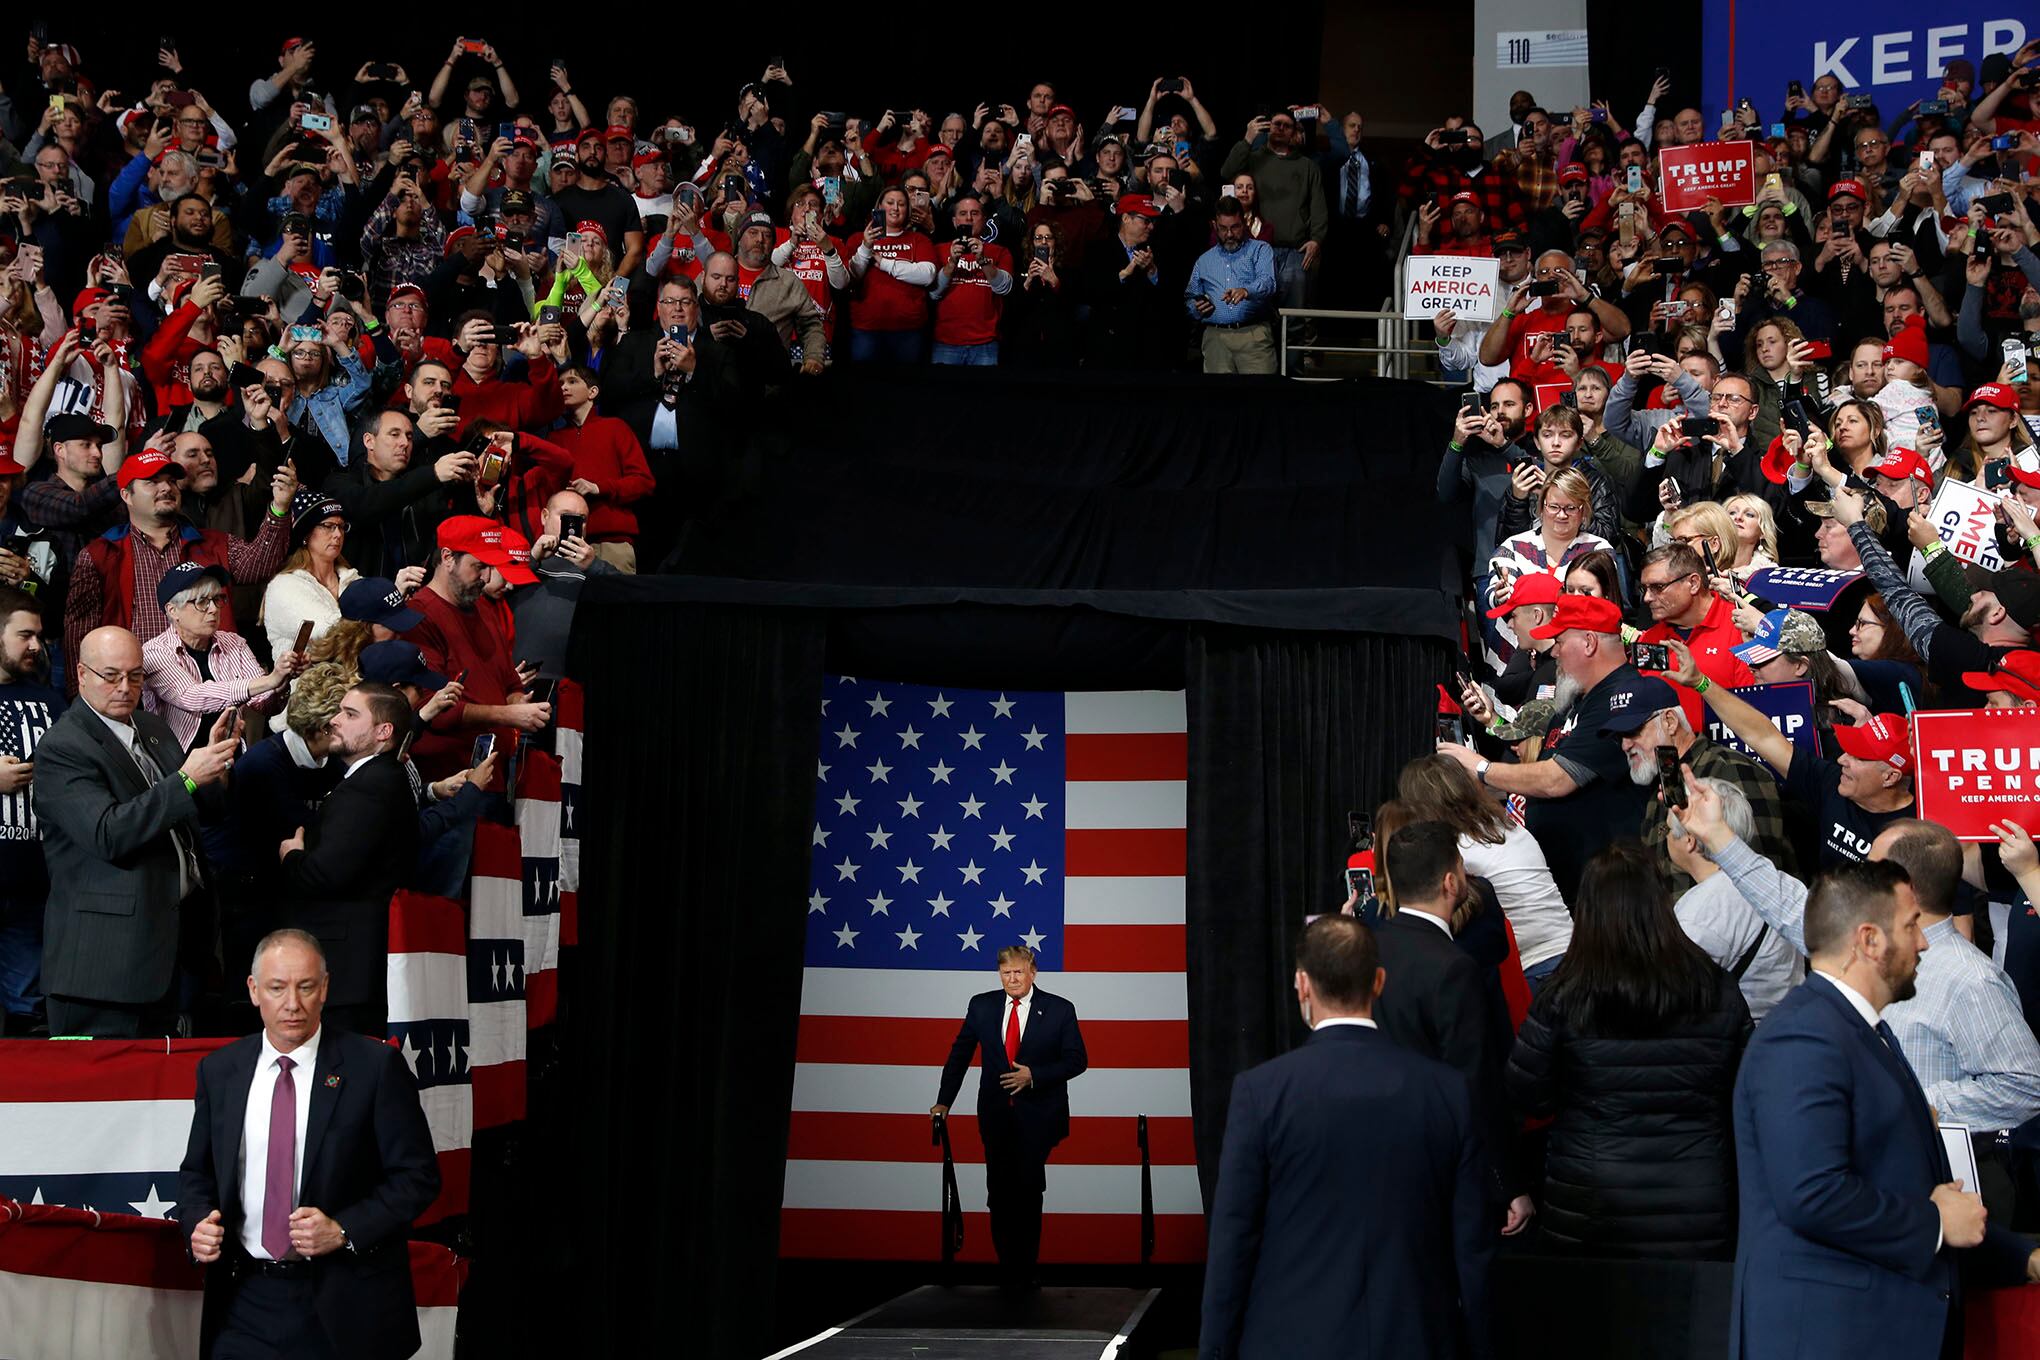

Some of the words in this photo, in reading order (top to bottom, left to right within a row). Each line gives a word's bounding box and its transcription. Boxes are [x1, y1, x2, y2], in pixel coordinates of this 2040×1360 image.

[1508, 38, 1530, 64] 110
[1813, 18, 2027, 89] KEEP
[1668, 159, 1747, 177] TRUMP
[1677, 173, 1741, 186] PENCE
[1431, 265, 1472, 277] KEEP
[1410, 280, 1491, 297] AMERICA
[1421, 297, 1477, 312] GREAT!
[1768, 570, 1840, 583] PENCE
[1782, 579, 1805, 587] AMERICA
[383, 590, 400, 603] TRU
[1961, 795, 1985, 803] KEEP
[1988, 794, 2031, 803] AMERICA
[1832, 822, 1872, 856] TRU
